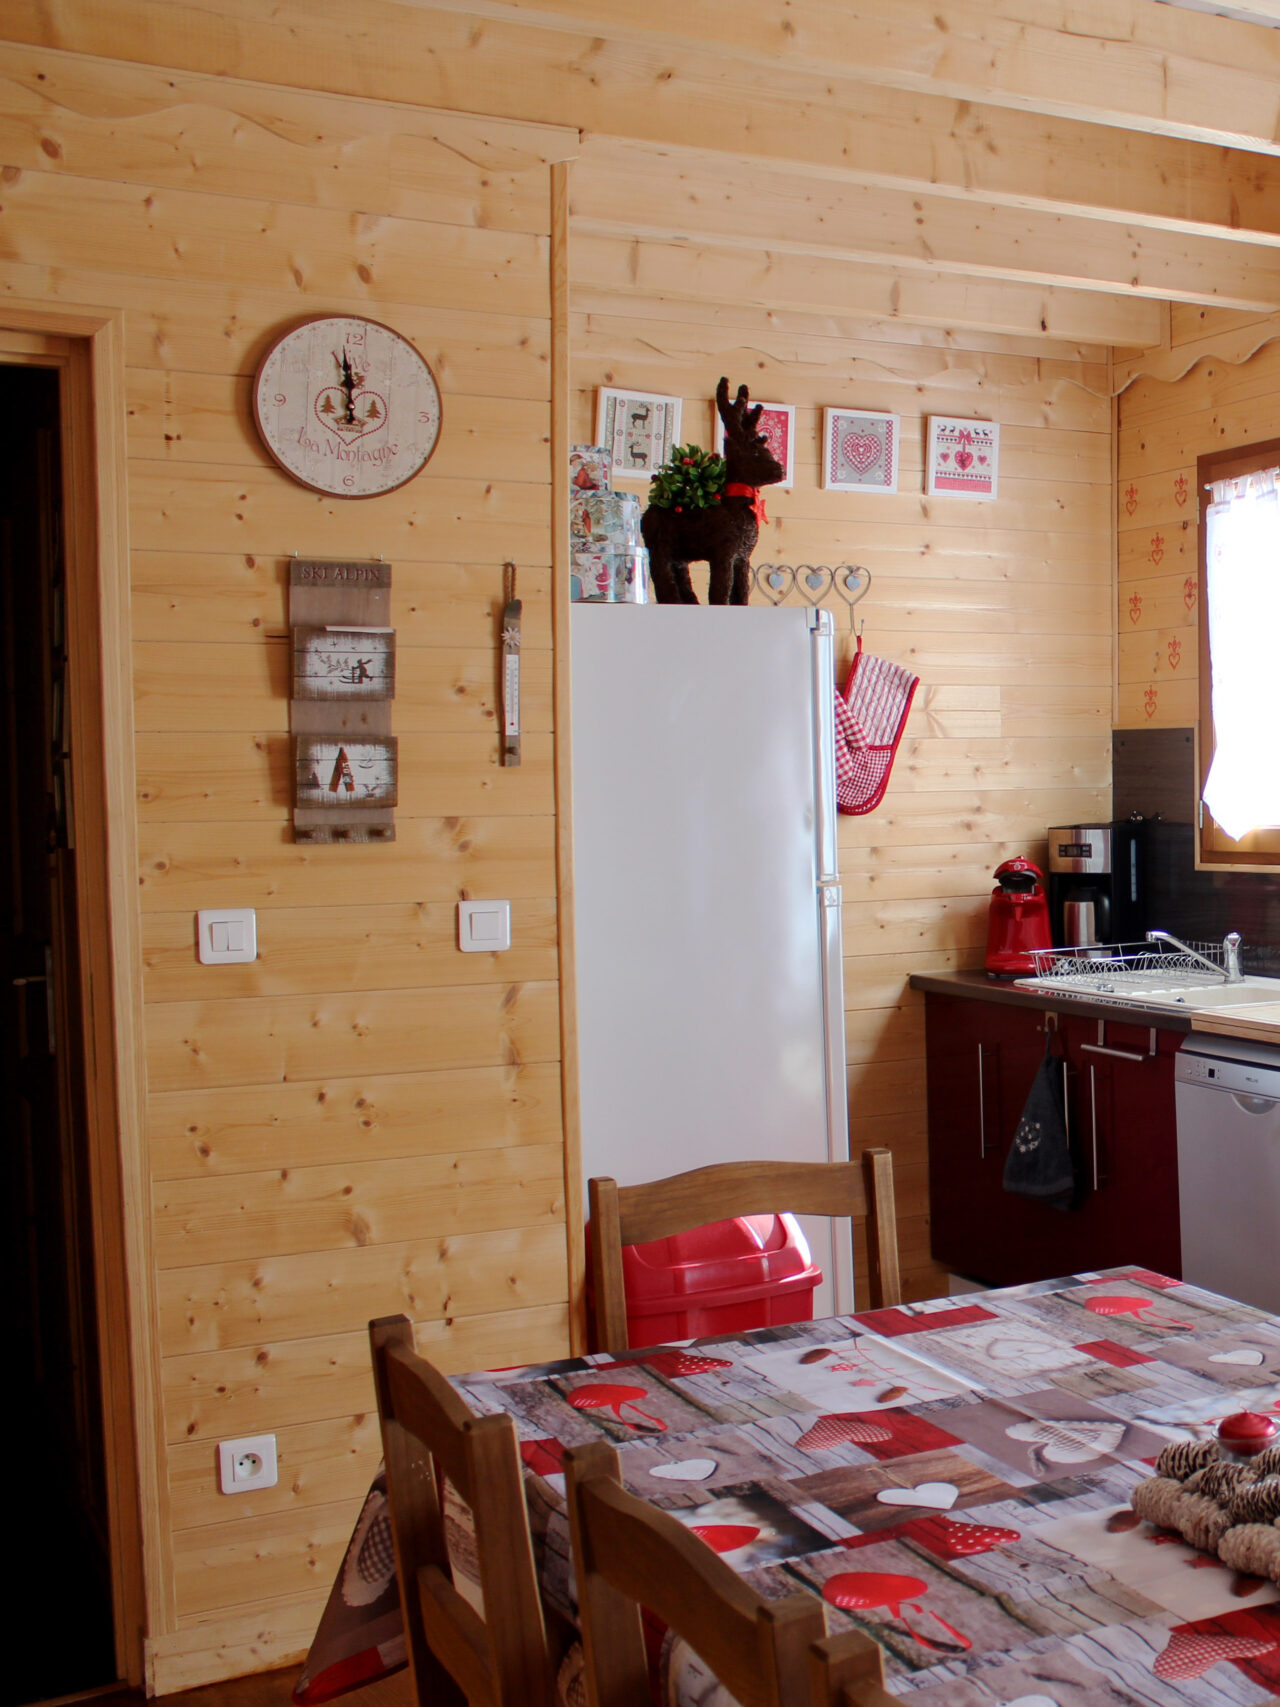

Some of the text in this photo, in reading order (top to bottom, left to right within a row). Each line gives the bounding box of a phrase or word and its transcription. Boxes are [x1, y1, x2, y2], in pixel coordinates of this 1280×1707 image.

[345, 332, 364, 346] 12
[272, 393, 287, 408] 9
[417, 411, 430, 424] 3
[323, 439, 400, 468] Montagne
[343, 474, 355, 487] 6
[301, 566, 380, 582] SKI ALPIN
